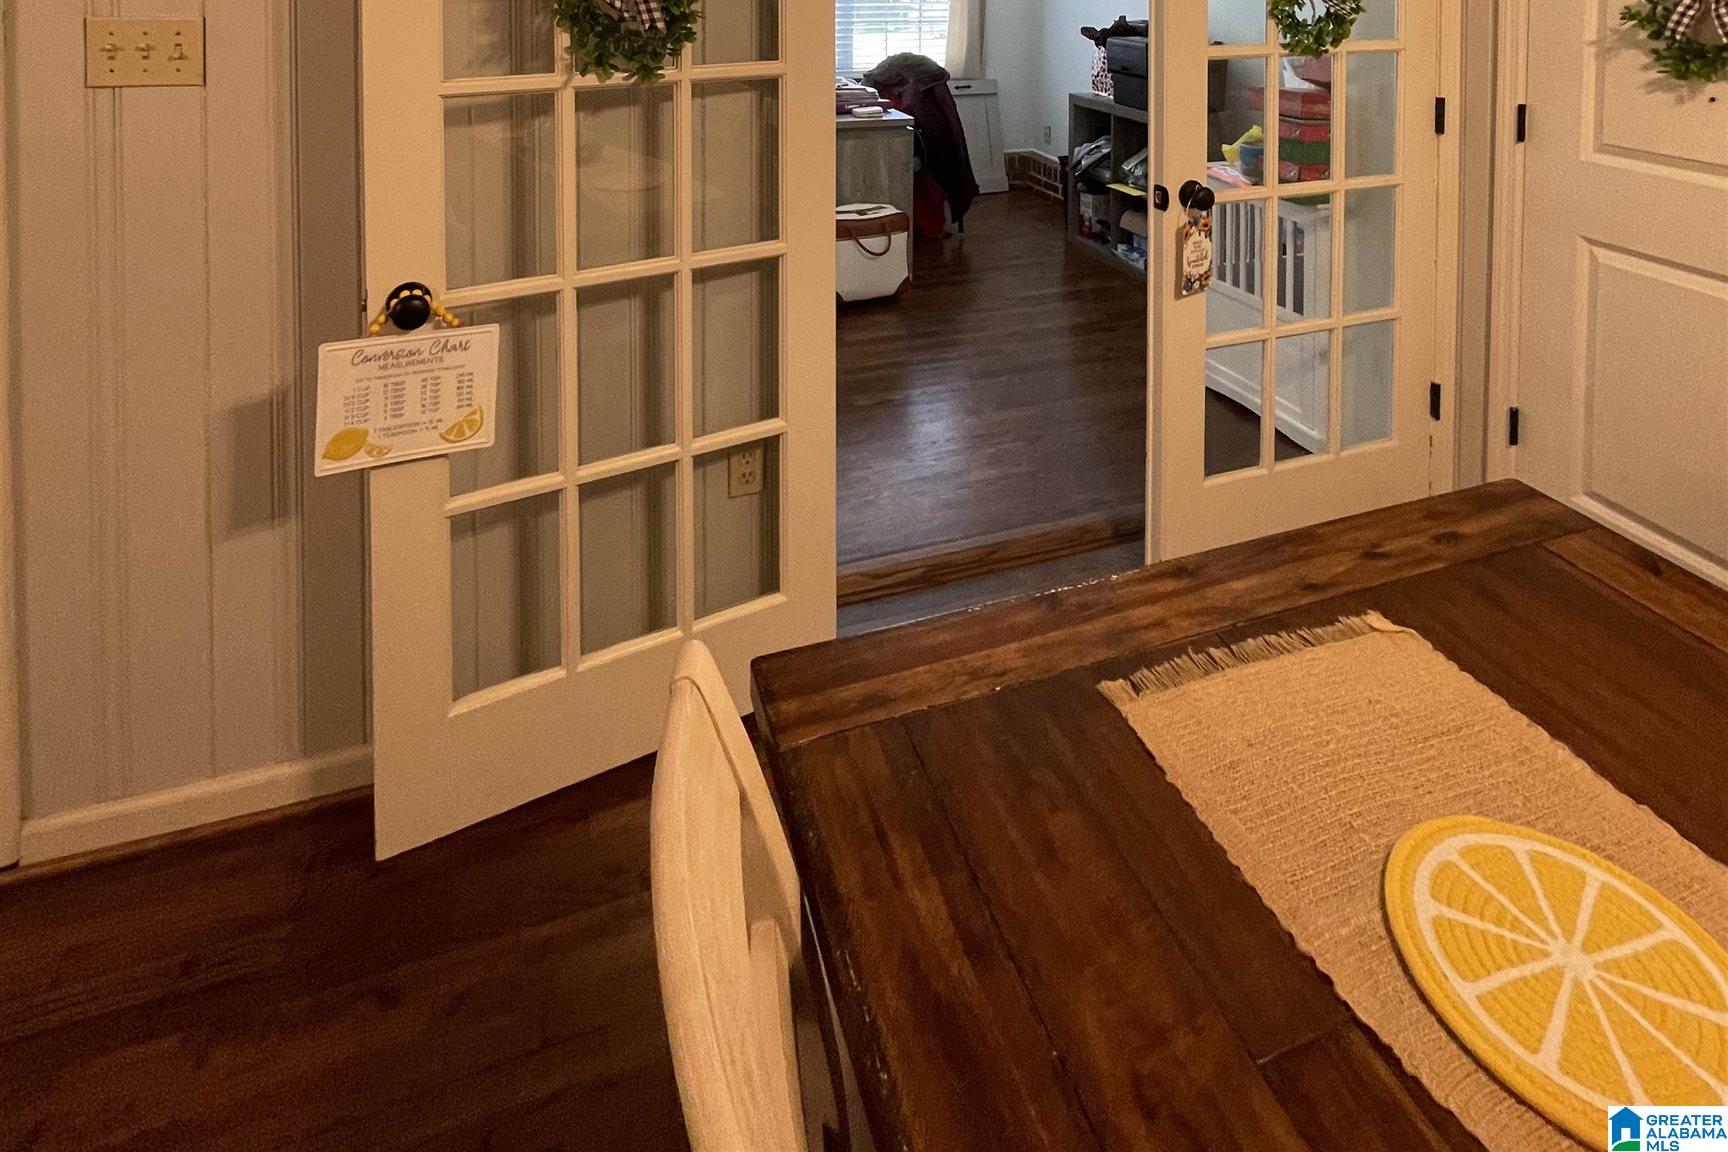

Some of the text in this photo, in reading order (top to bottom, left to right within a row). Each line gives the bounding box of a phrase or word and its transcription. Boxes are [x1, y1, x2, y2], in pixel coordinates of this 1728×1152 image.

[351, 338, 471, 366] Conversion Chart
[378, 356, 444, 370] MEASUREMENTS
